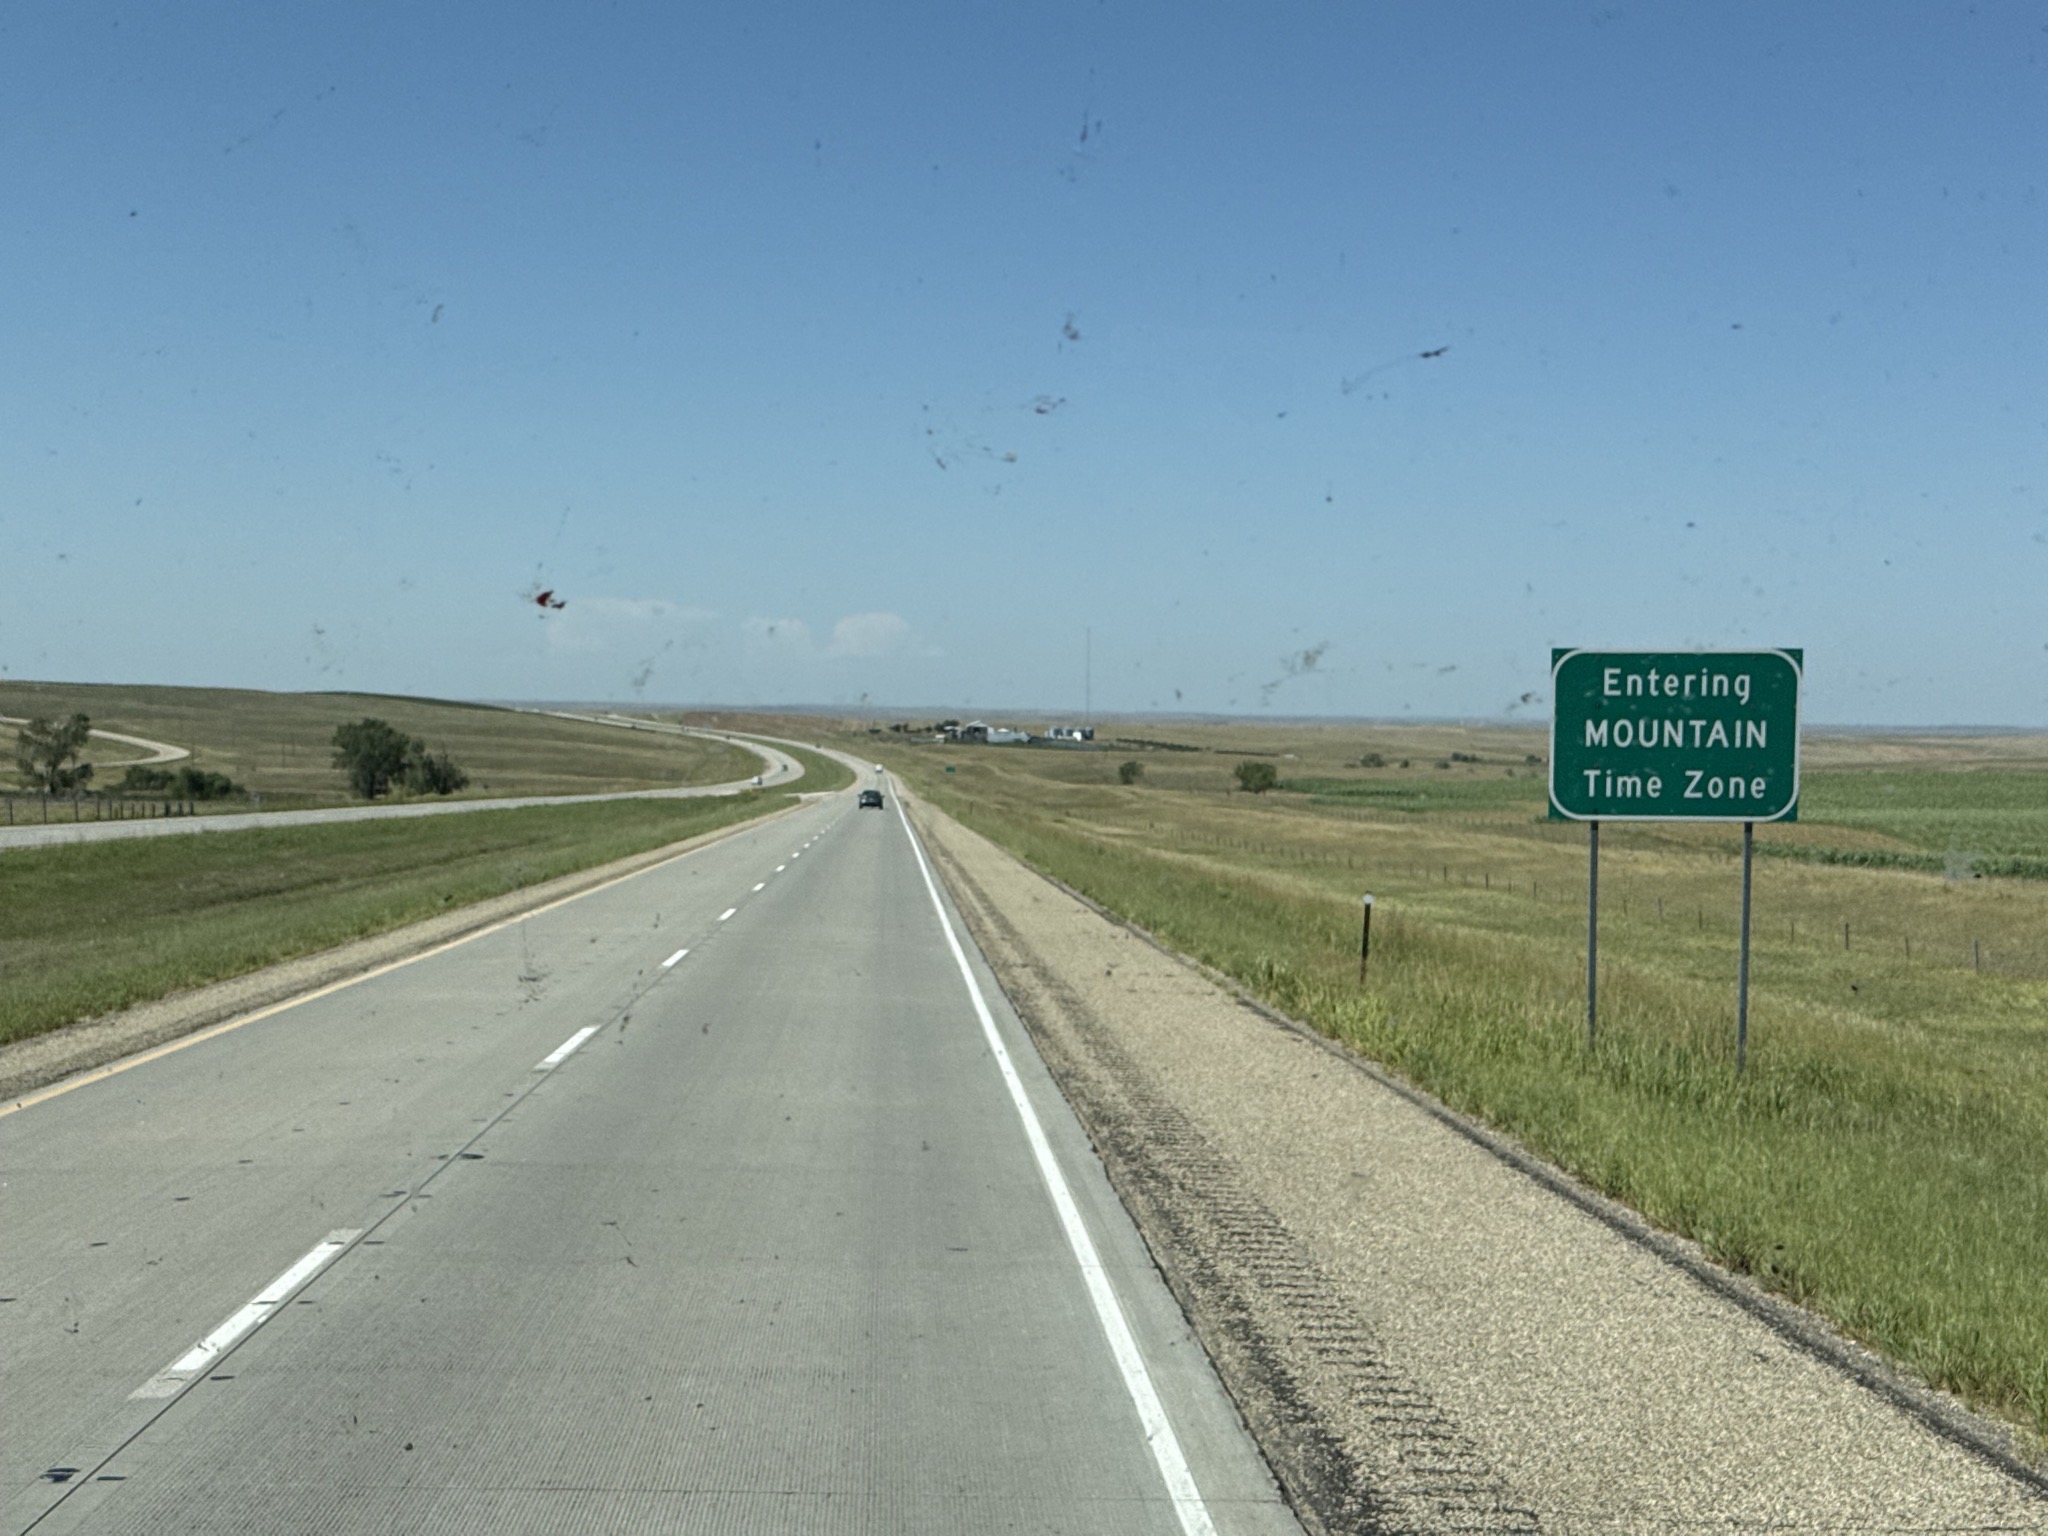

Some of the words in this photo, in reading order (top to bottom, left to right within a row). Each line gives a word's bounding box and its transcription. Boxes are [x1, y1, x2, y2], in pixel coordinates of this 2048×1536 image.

[1603, 668, 1751, 705] Entering
[1585, 719, 1767, 748] MOUNTAIN
[1583, 769, 1663, 798] Time
[1683, 770, 1767, 799] Zone
